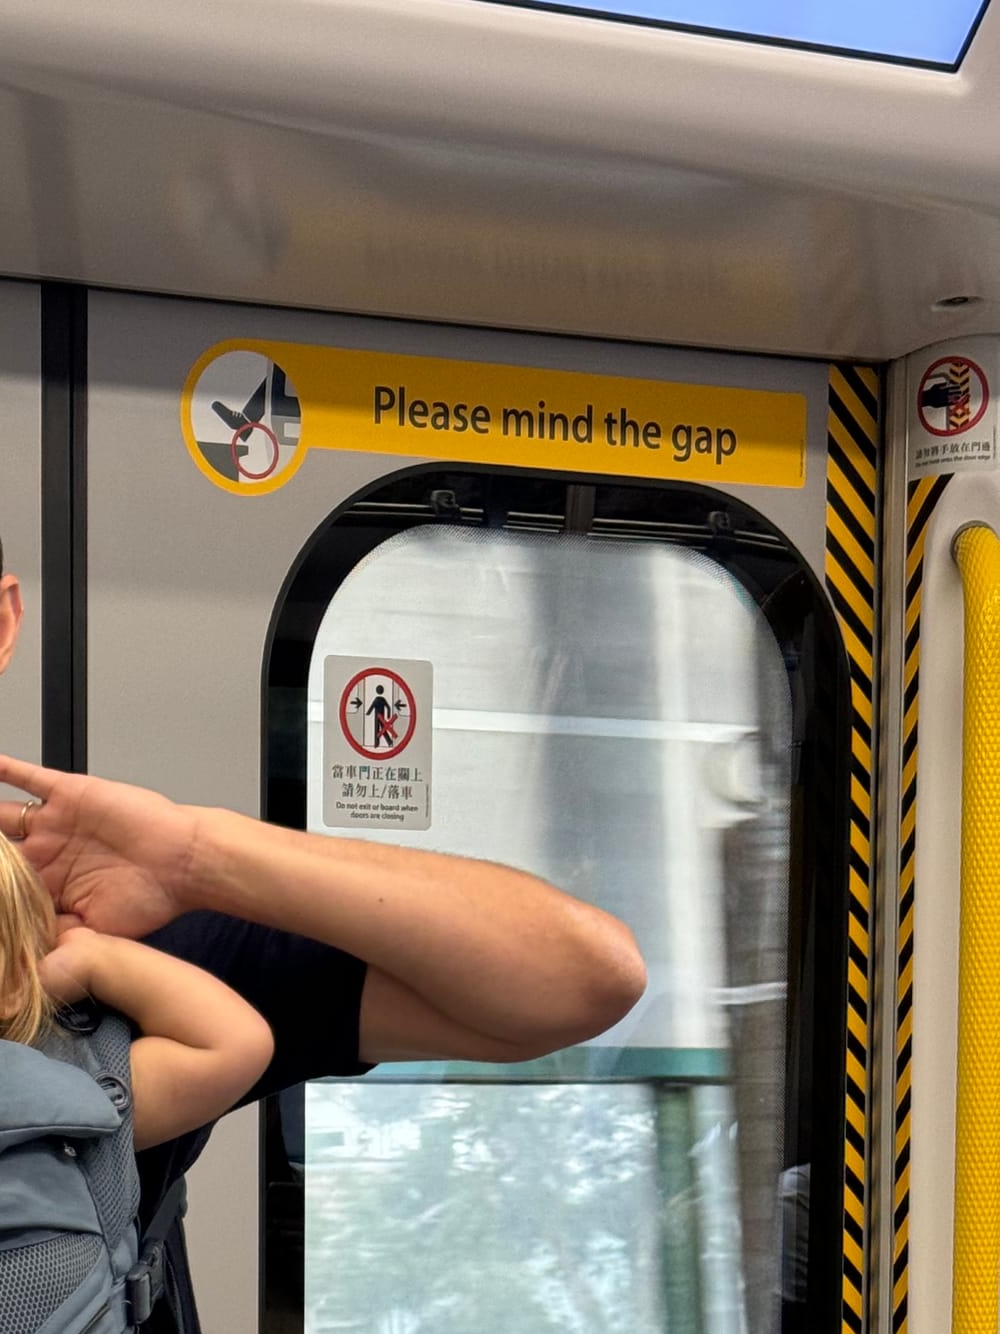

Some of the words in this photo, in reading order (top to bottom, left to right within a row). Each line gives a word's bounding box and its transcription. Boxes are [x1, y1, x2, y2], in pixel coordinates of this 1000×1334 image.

[373, 385, 491, 434] Please
[502, 400, 593, 443] mind
[604, 407, 662, 449] the
[671, 422, 737, 465] gap
[332, 764, 423, 782] 當車門正在關上
[342, 782, 413, 800] 請勿上/落車
[382, 812, 404, 820] closing
